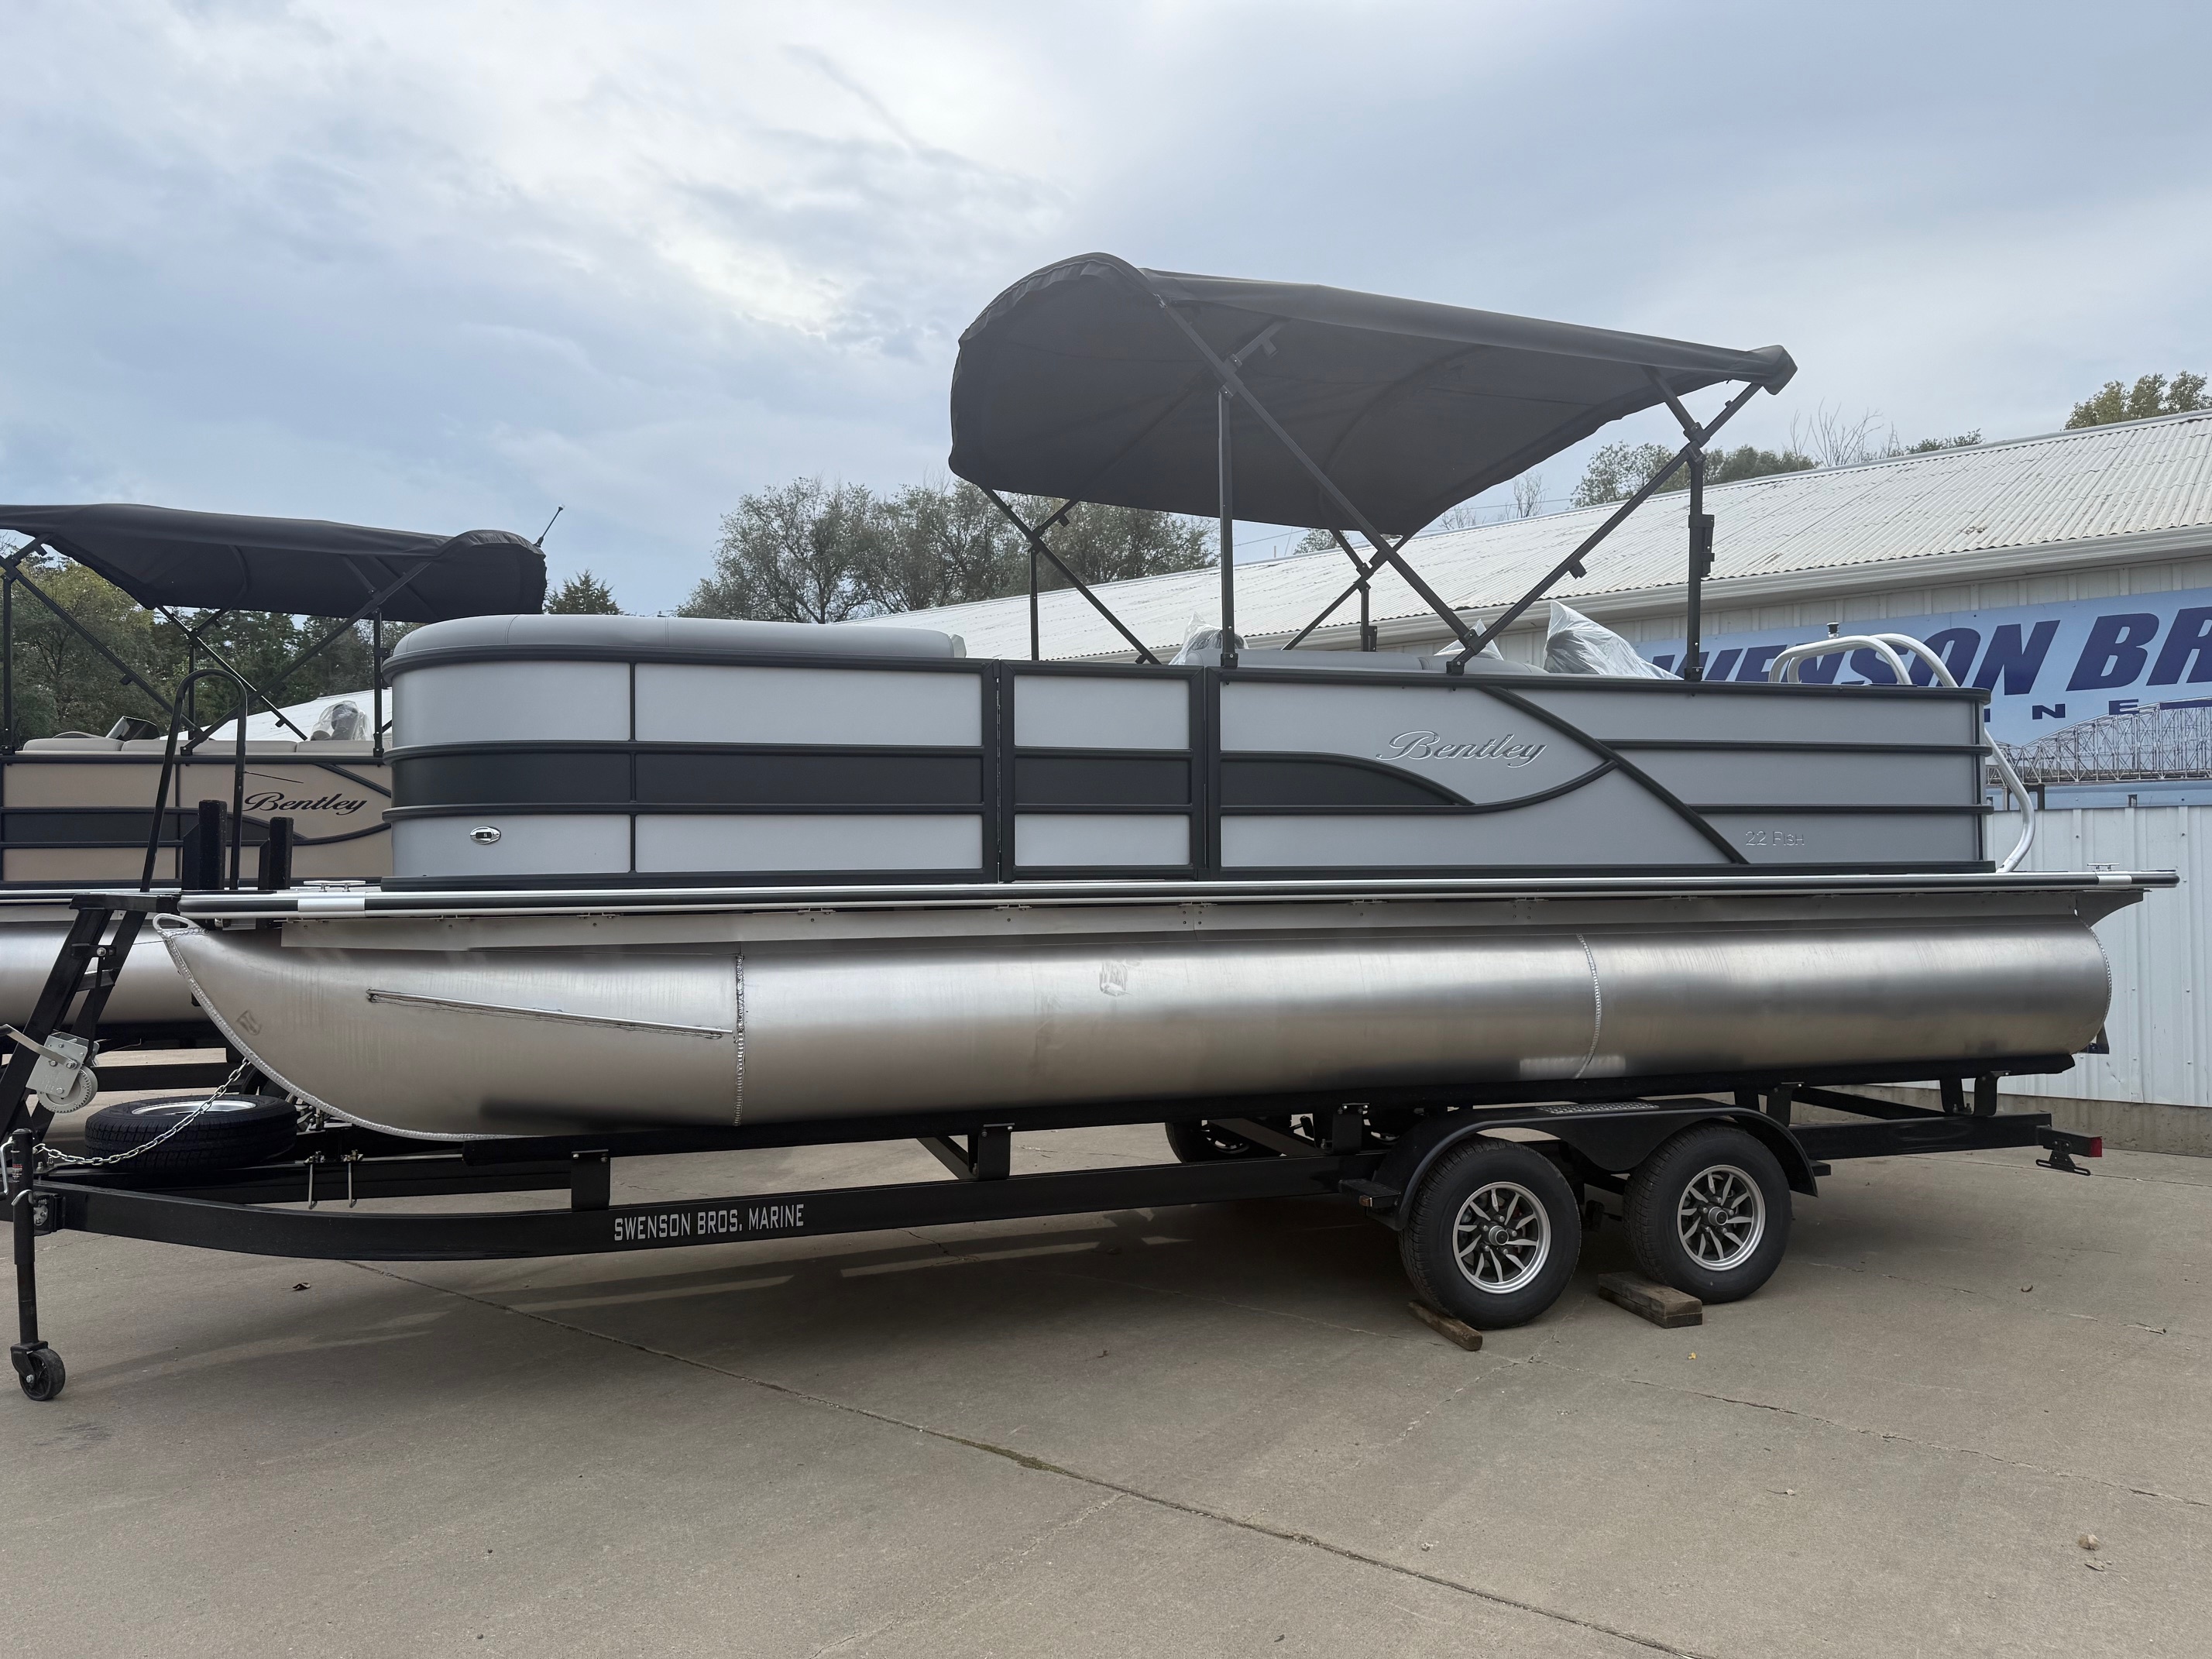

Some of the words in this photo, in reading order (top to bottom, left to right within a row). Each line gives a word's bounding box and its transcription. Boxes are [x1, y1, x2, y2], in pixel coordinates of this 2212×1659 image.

[1376, 730, 1547, 768] Bentley
[242, 792, 367, 816] Bentley
[1745, 830, 1767, 846] 22
[614, 1213, 690, 1241] SWENSON
[698, 1209, 743, 1235] BROS.
[748, 1204, 805, 1231] MARINE
